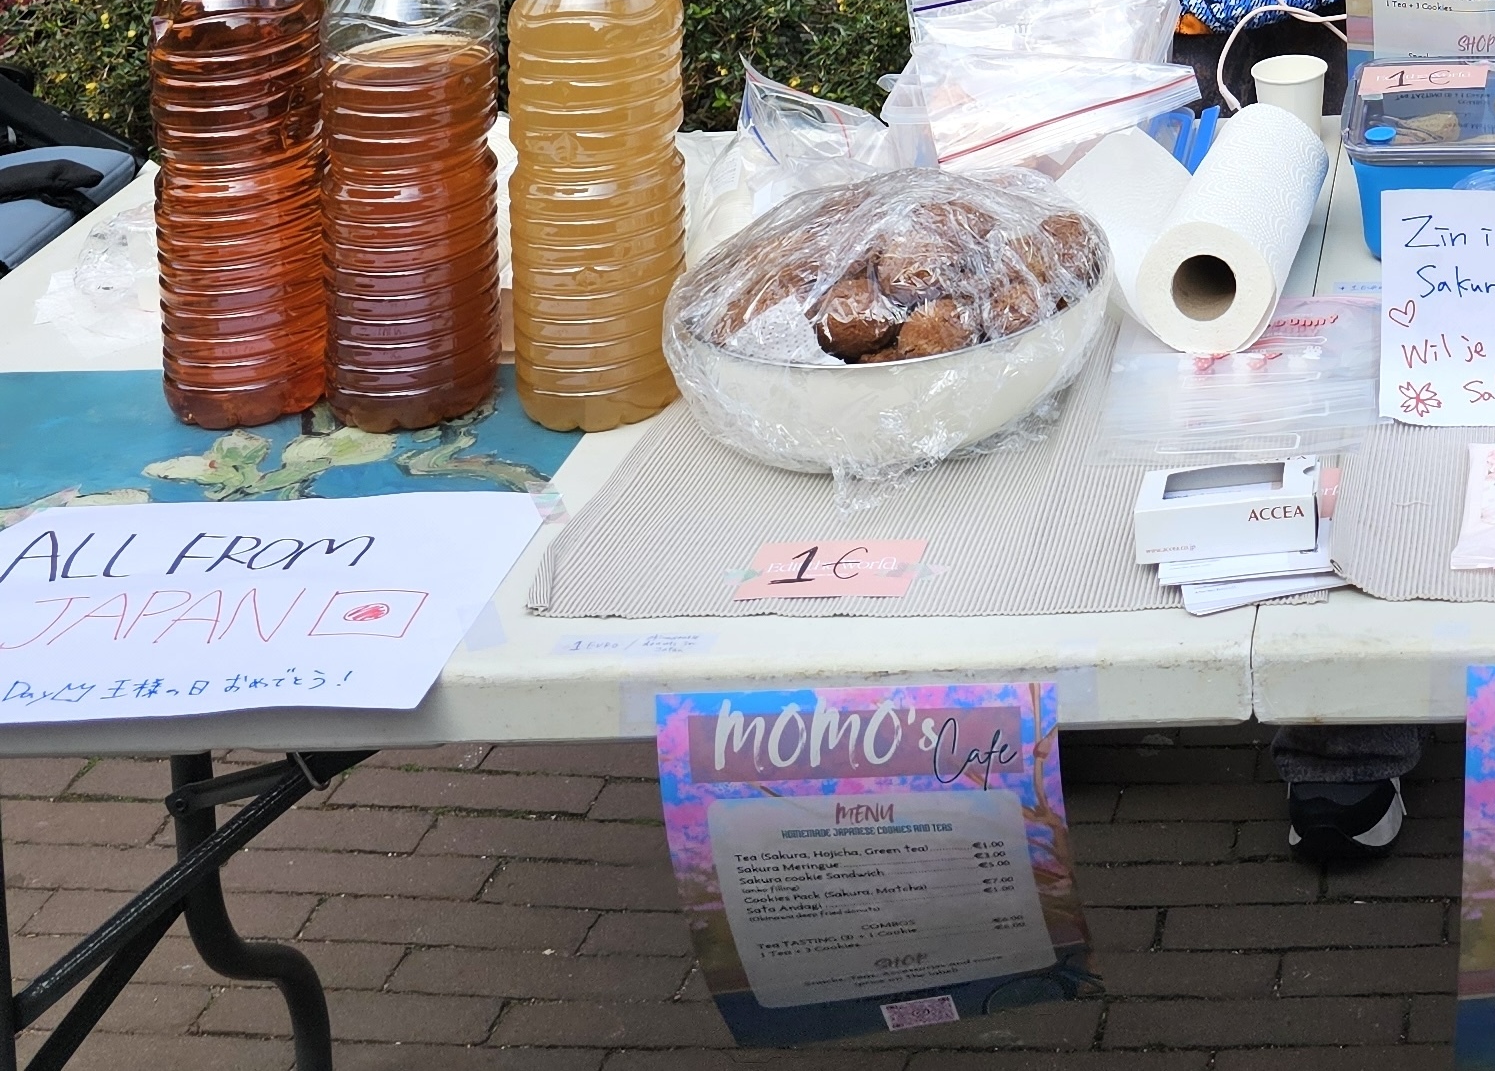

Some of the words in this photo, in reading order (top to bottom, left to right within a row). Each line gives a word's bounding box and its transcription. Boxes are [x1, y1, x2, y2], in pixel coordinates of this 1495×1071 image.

[1422, 3, 1452, 11] Cookies
[1458, 34, 1495, 54] SHOP
[1401, 214, 1467, 249] Zin
[1401, 333, 1451, 369] Wil
[1461, 335, 1485, 362] je
[1248, 505, 1304, 522] ACCEA
[0, 530, 137, 583] ALL
[166, 532, 375, 574] FROM
[0, 587, 305, 650] JAPAN
[714, 698, 938, 774] MOMO's
[836, 802, 894, 824] MENU
[735, 854, 756, 862] Tea
[761, 851, 810, 861] (Sakura,
[813, 848, 862, 859] Hojicha,
[865, 847, 900, 855] Green
[737, 864, 779, 874] Sakura
[783, 862, 839, 871] Meringue
[740, 877, 781, 885] Sakura
[826, 869, 884, 878] Sandwich
[744, 895, 790, 904] Cookies
